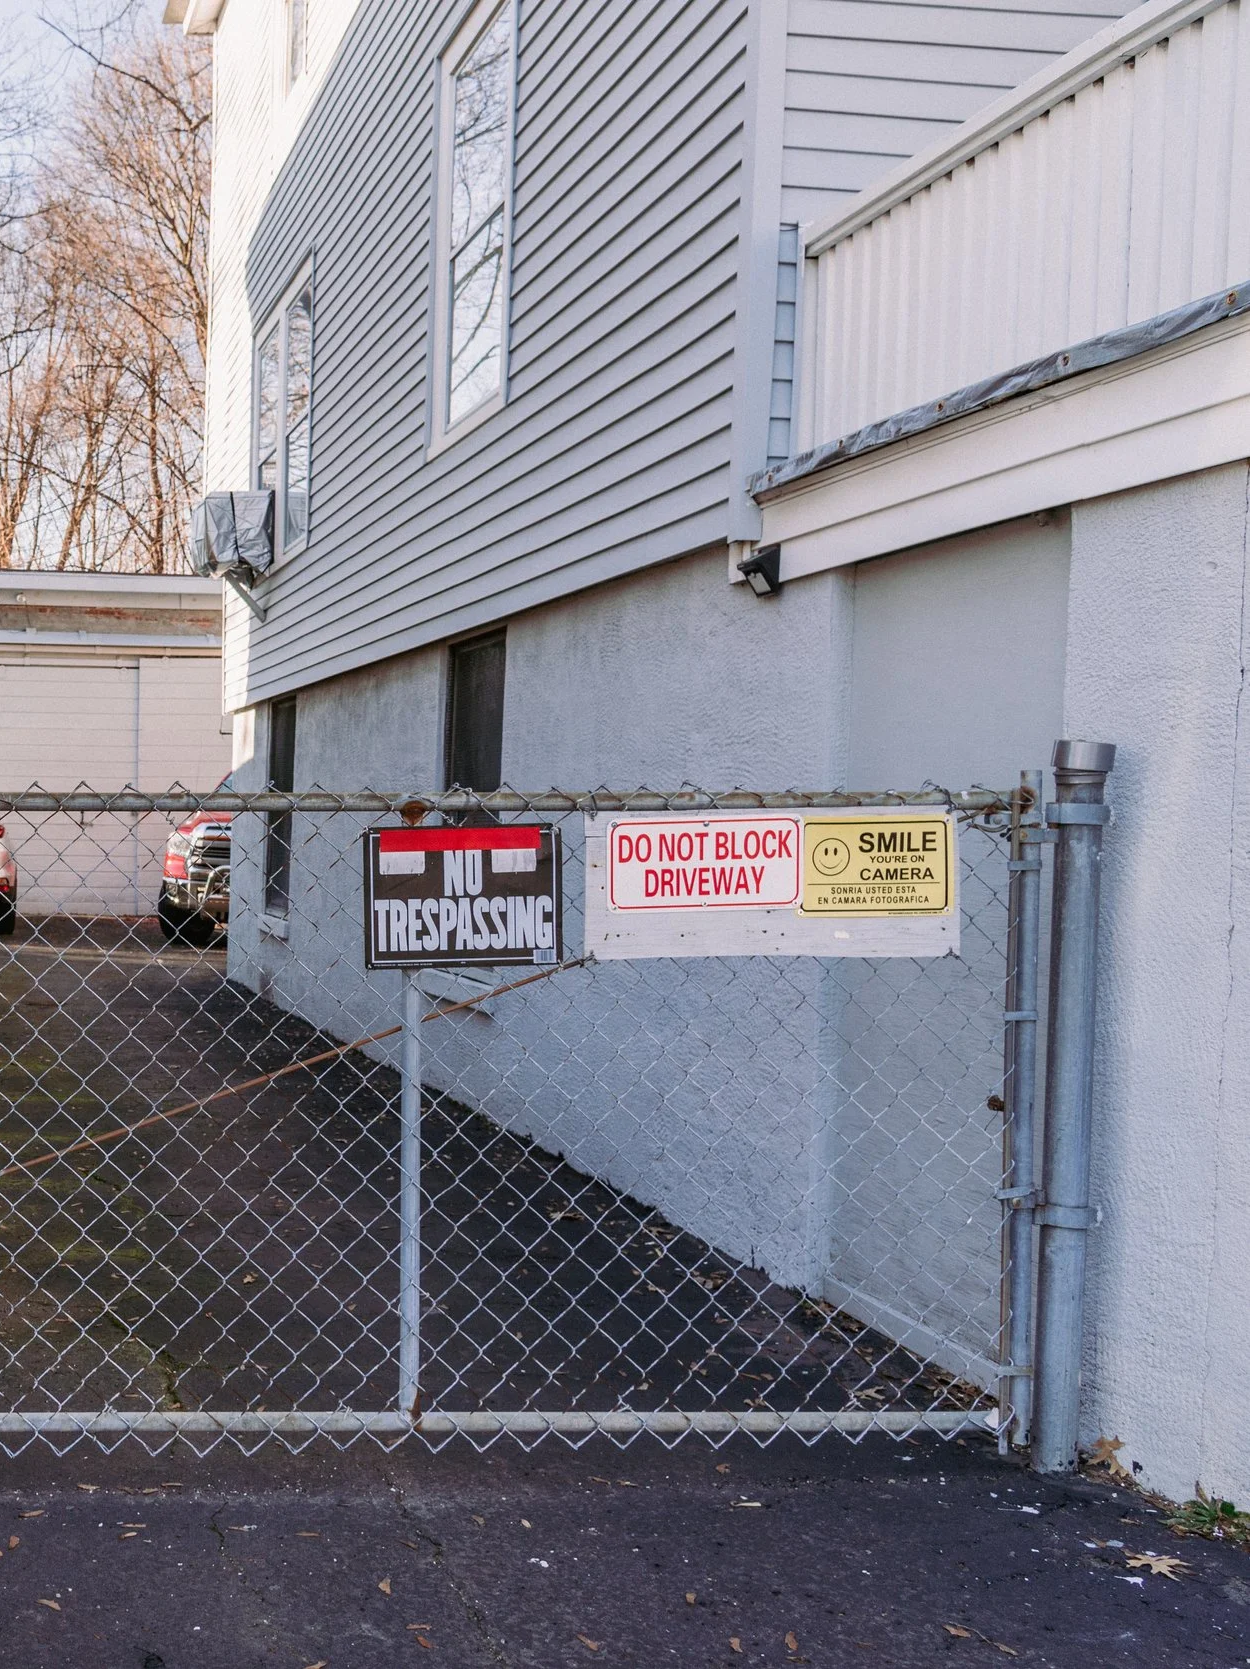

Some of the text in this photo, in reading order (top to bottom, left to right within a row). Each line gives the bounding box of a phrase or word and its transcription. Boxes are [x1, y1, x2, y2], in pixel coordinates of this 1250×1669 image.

[618, 829, 793, 864] DO NOT BLOCK
[858, 831, 938, 853] SMILE
[869, 854, 925, 864] YOU'RE ON
[443, 850, 483, 896] NO
[645, 865, 765, 898] DRIVEWAY
[859, 867, 935, 881] CAMERA
[817, 895, 930, 905] EN CAMARA FOTOGRAFICA
[830, 886, 863, 895] SONRIA
[865, 886, 893, 894] USTED
[375, 895, 553, 951] TRESPASSING
